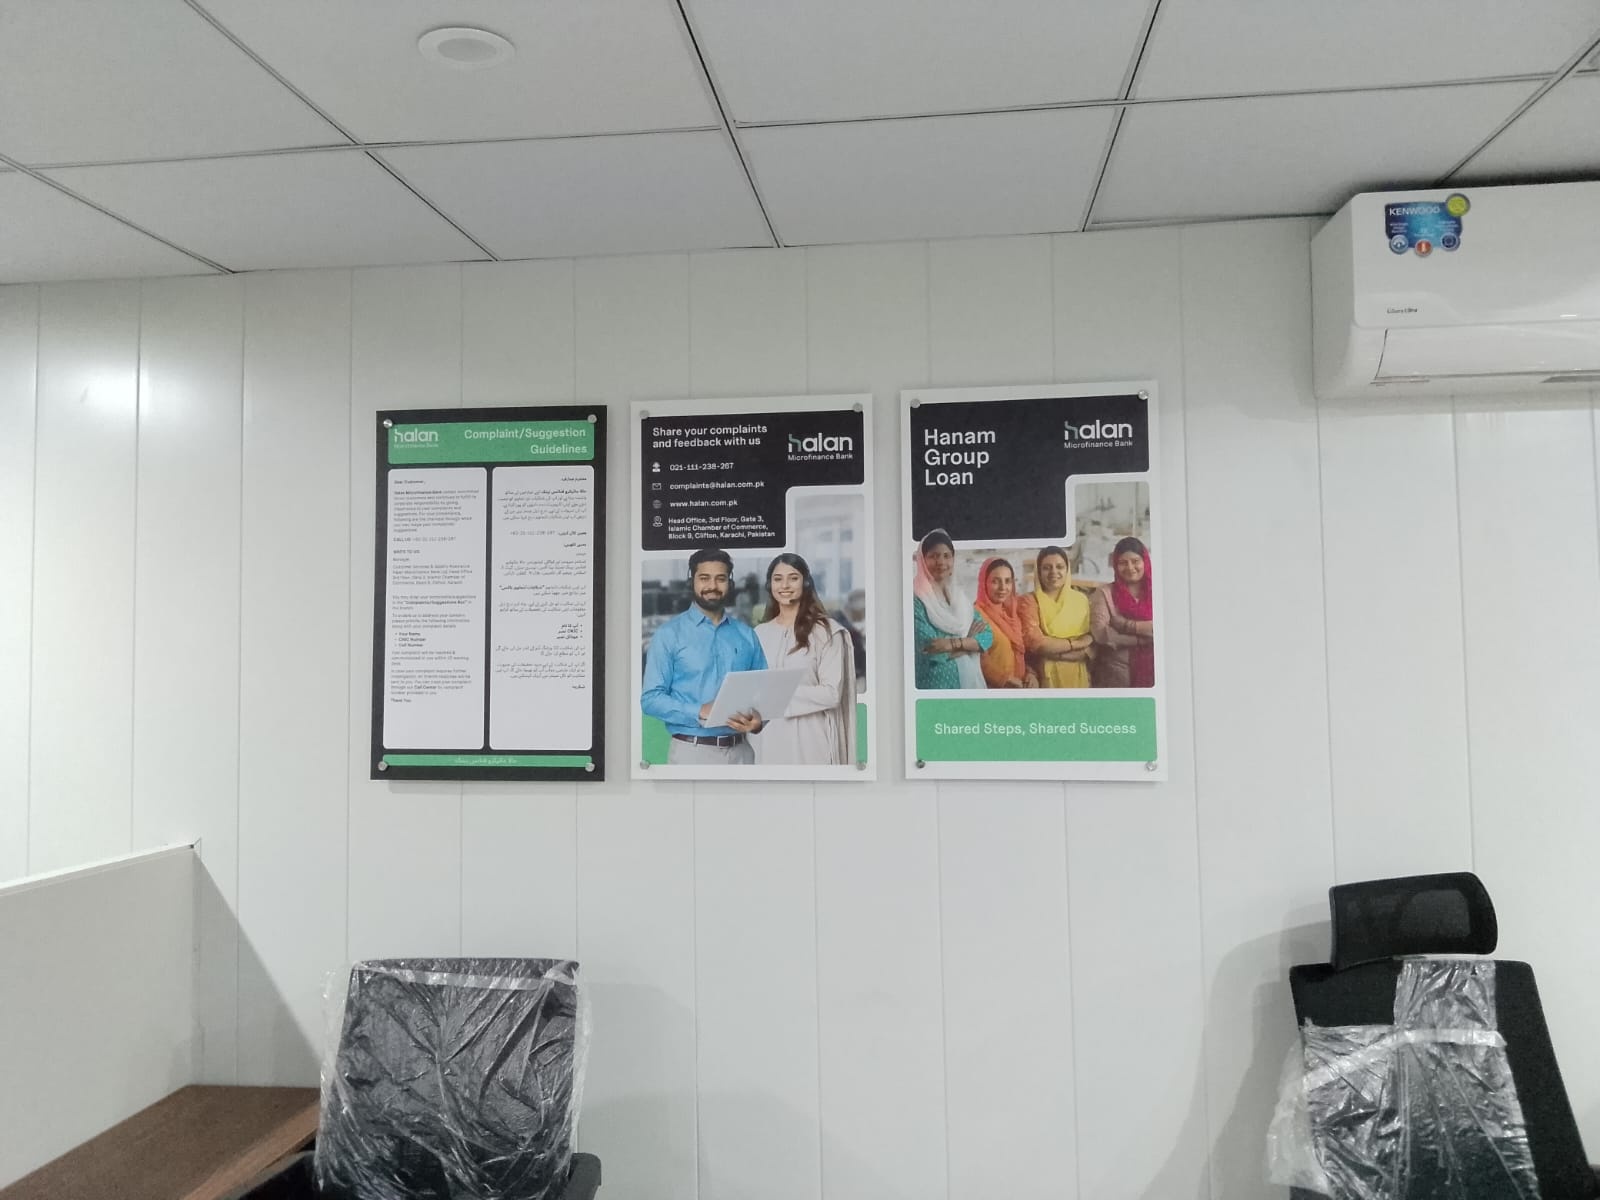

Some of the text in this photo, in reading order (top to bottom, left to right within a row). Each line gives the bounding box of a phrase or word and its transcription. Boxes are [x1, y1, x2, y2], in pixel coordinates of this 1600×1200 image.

[1389, 206, 1441, 216] KENWOOD
[394, 428, 439, 443] halan
[464, 427, 586, 440] Complaint/Suggestion
[652, 424, 768, 438] Share your complaints
[1064, 419, 1133, 440] halan
[652, 437, 761, 449] and feedback with us
[788, 432, 853, 453] halan
[924, 428, 996, 446] Hanam
[530, 444, 588, 455] Guidelines
[1064, 440, 1113, 449] Microfinance
[787, 453, 835, 461] Microfinance
[924, 448, 990, 468] Group
[924, 469, 974, 486] Loan
[669, 481, 765, 491] complaints@halan.com.pk
[669, 499, 738, 509] www.halan.com.pk
[730, 523, 768, 531] Commerce,
[668, 532, 686, 540] Block
[934, 722, 1137, 736] Shared Steps, Shared Success
